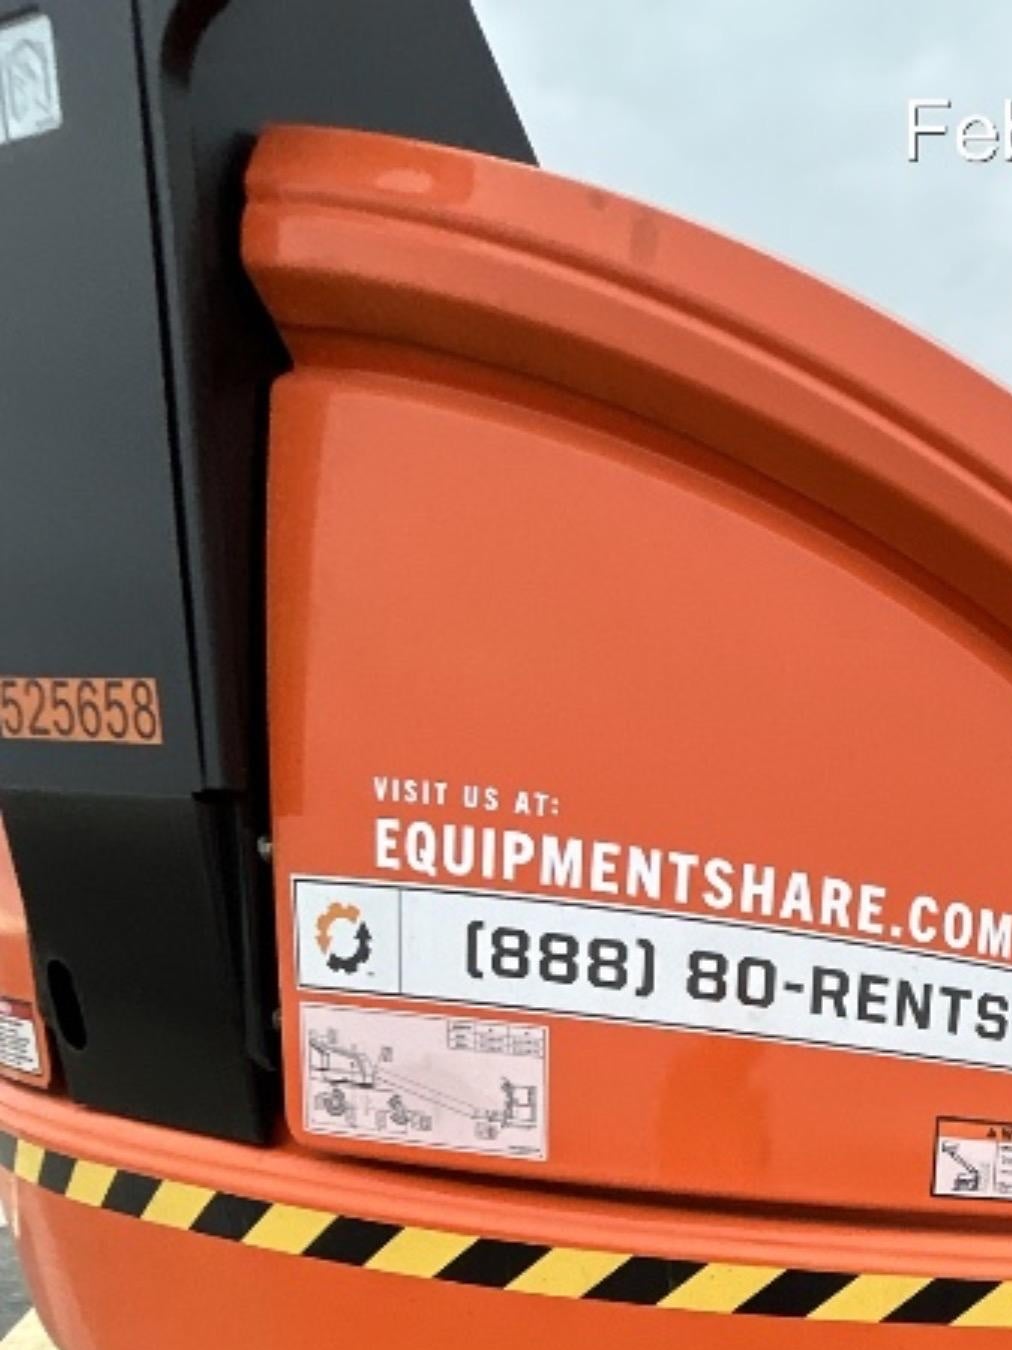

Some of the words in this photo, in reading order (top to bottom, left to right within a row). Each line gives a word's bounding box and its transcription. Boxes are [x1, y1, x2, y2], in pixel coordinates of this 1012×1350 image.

[0, 680, 157, 740] 525658
[374, 777, 448, 804] VISIT
[463, 786, 499, 811] US
[514, 792, 559, 816] AT:
[466, 921, 654, 997] (888)
[686, 950, 1009, 1042] 80-RENTS
